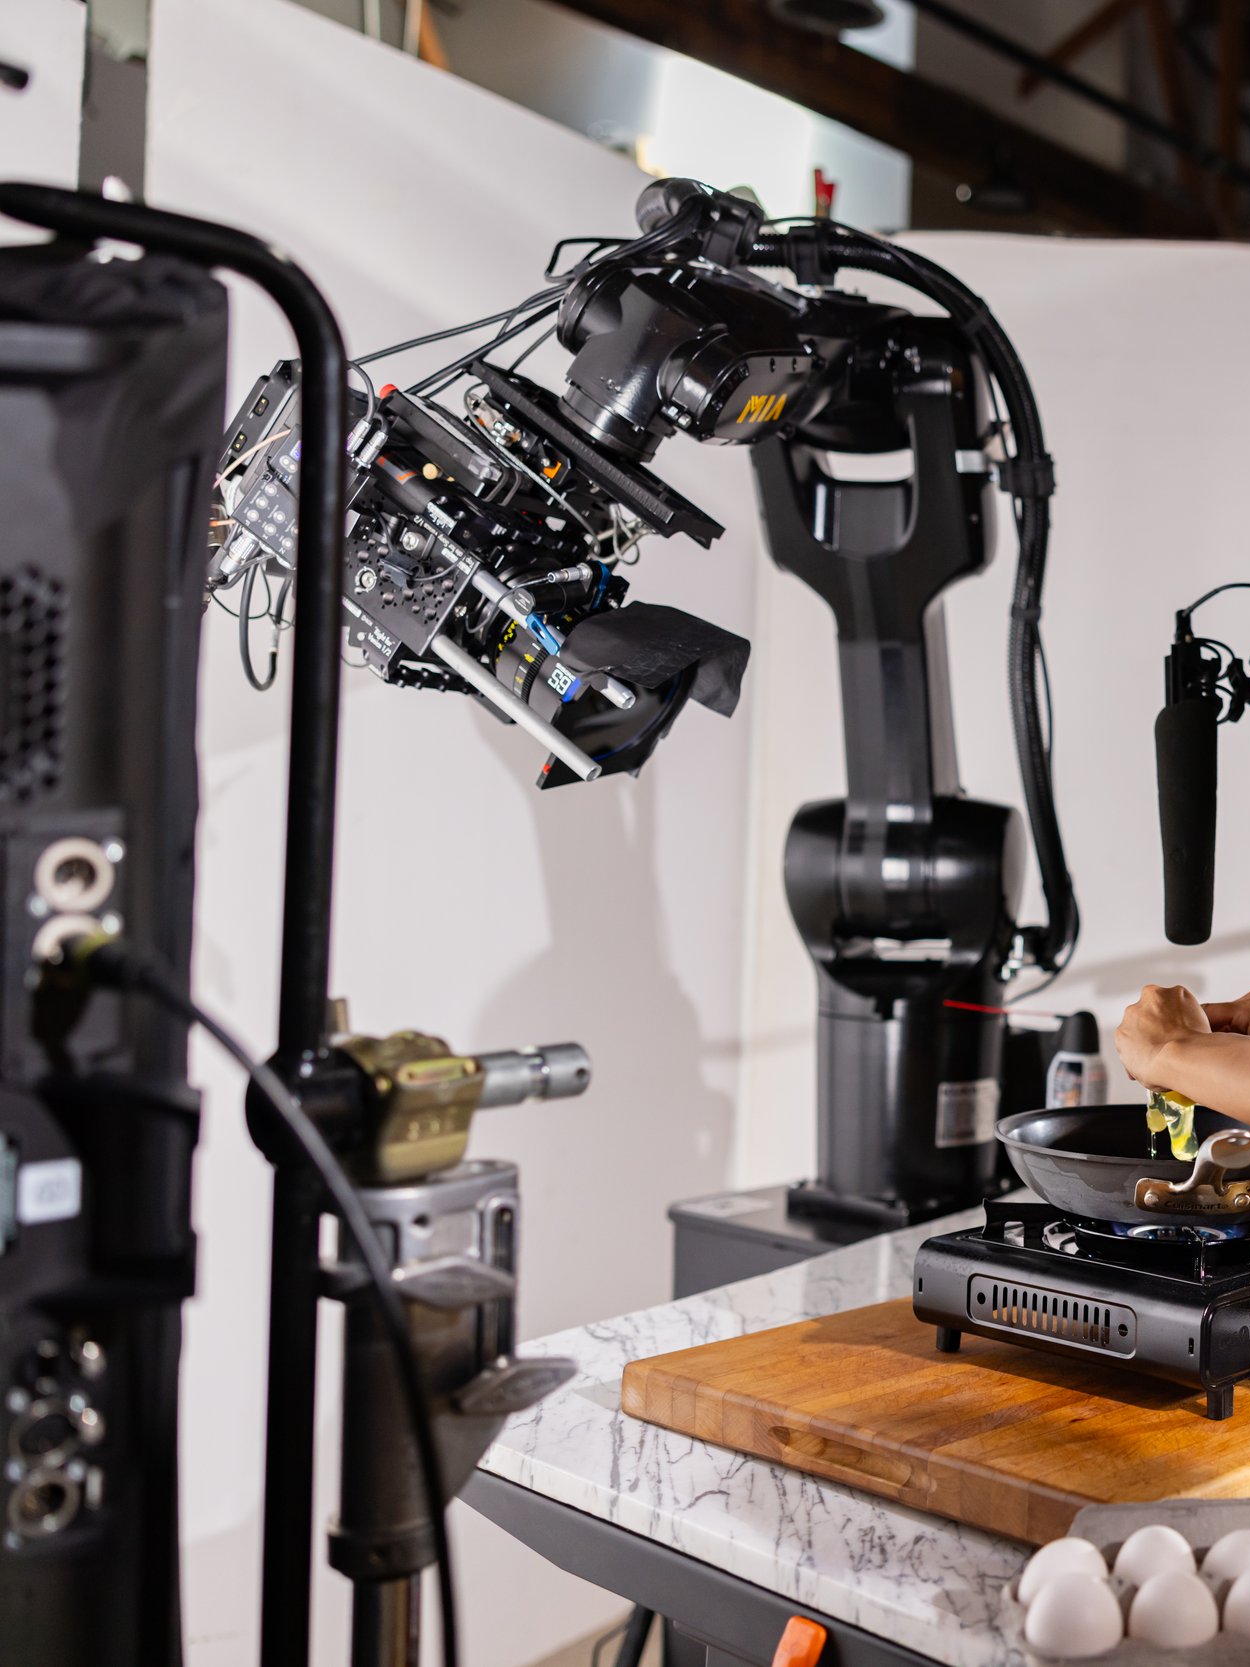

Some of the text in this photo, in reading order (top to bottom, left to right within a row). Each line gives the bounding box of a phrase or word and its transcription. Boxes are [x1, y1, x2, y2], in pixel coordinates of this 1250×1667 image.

[736, 393, 788, 423] MIA
[547, 669, 573, 696] 65
[1164, 1200, 1222, 1210] Cuisinart
